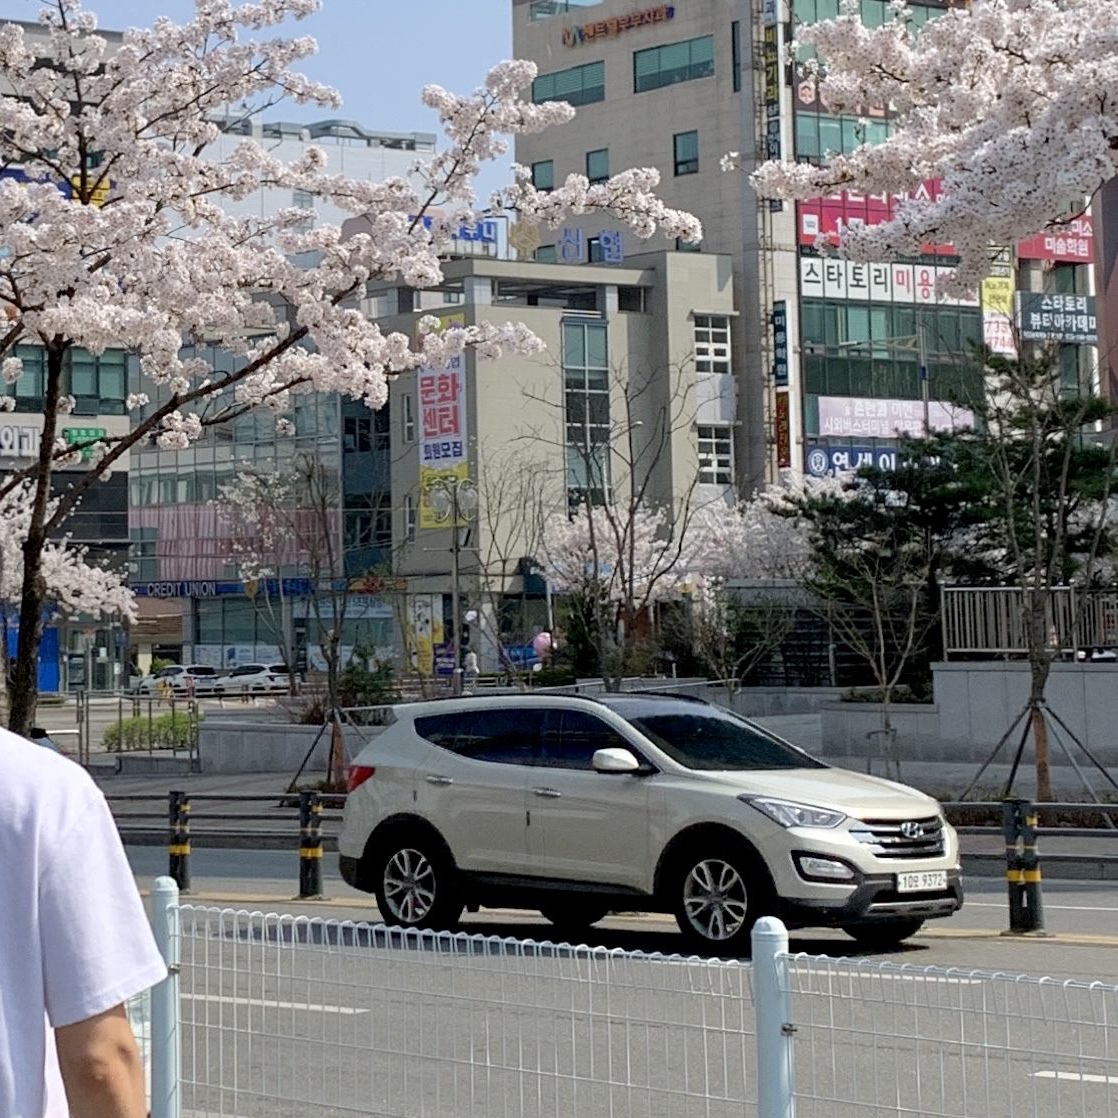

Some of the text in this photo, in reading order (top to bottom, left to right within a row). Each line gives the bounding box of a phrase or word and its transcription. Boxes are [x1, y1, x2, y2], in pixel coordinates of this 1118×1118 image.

[1044, 237, 1089, 257] 미술학원
[1041, 295, 1087, 312] 스타토리
[420, 372, 459, 406] 문화
[422, 406, 461, 439] 센터
[824, 415, 889, 434] 시외버스터미널
[423, 441, 463, 460] 회원모집
[147, 582, 183, 597] CREDIT
[184, 582, 216, 596] UNION
[921, 873, 943, 888] 9372
